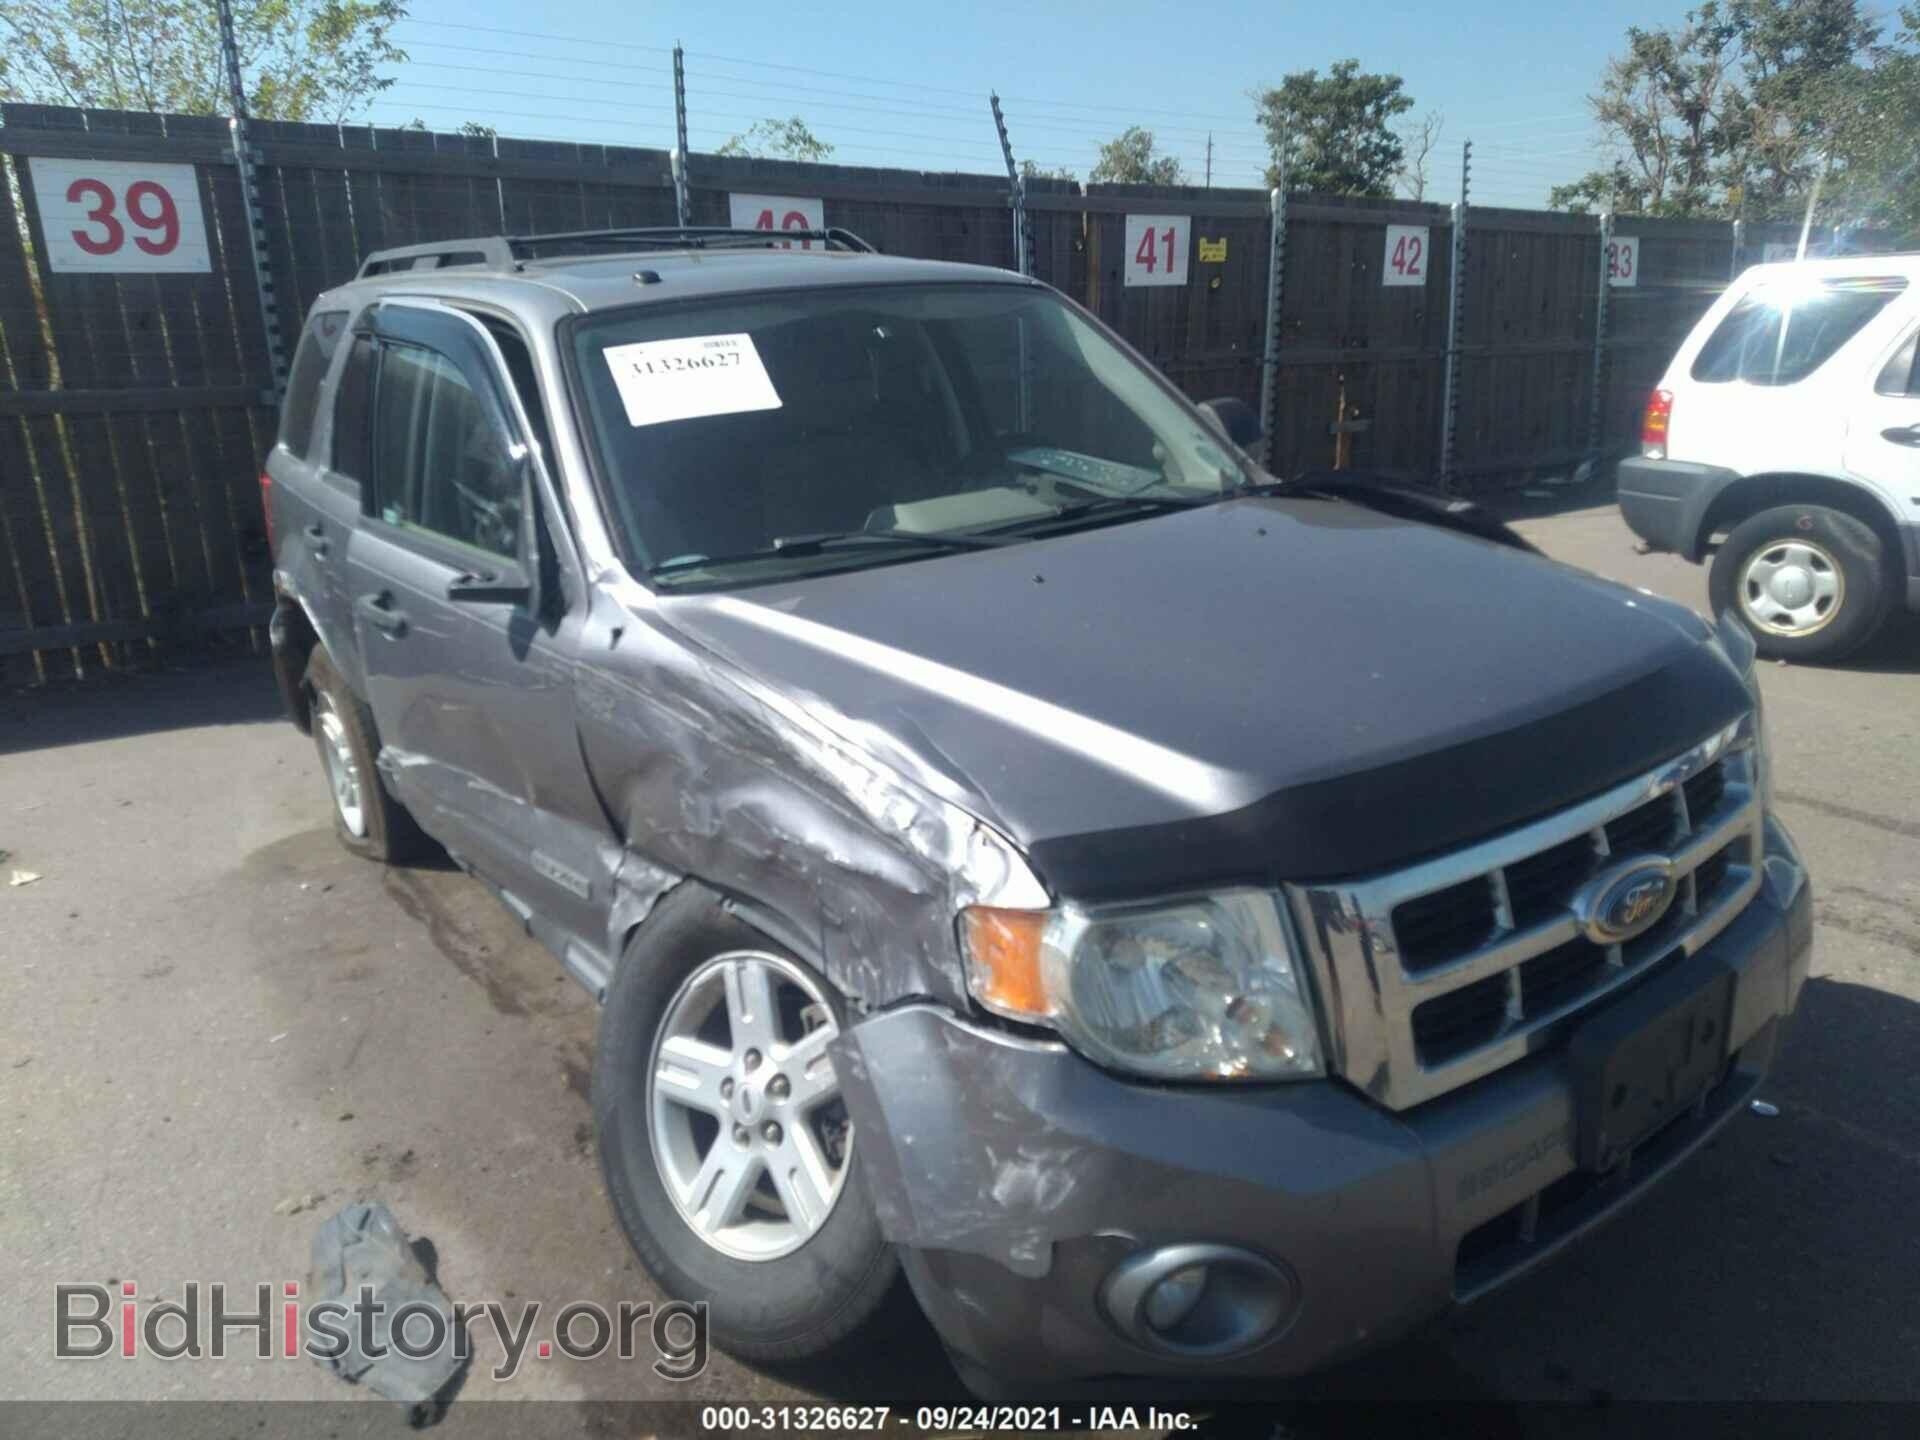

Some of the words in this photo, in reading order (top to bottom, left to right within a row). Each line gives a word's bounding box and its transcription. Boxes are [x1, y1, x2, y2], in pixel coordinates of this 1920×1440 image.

[66, 178, 180, 256] 39
[1135, 226, 1176, 273] 41
[1391, 235, 1422, 275] 42
[631, 352, 740, 379] 31326627
